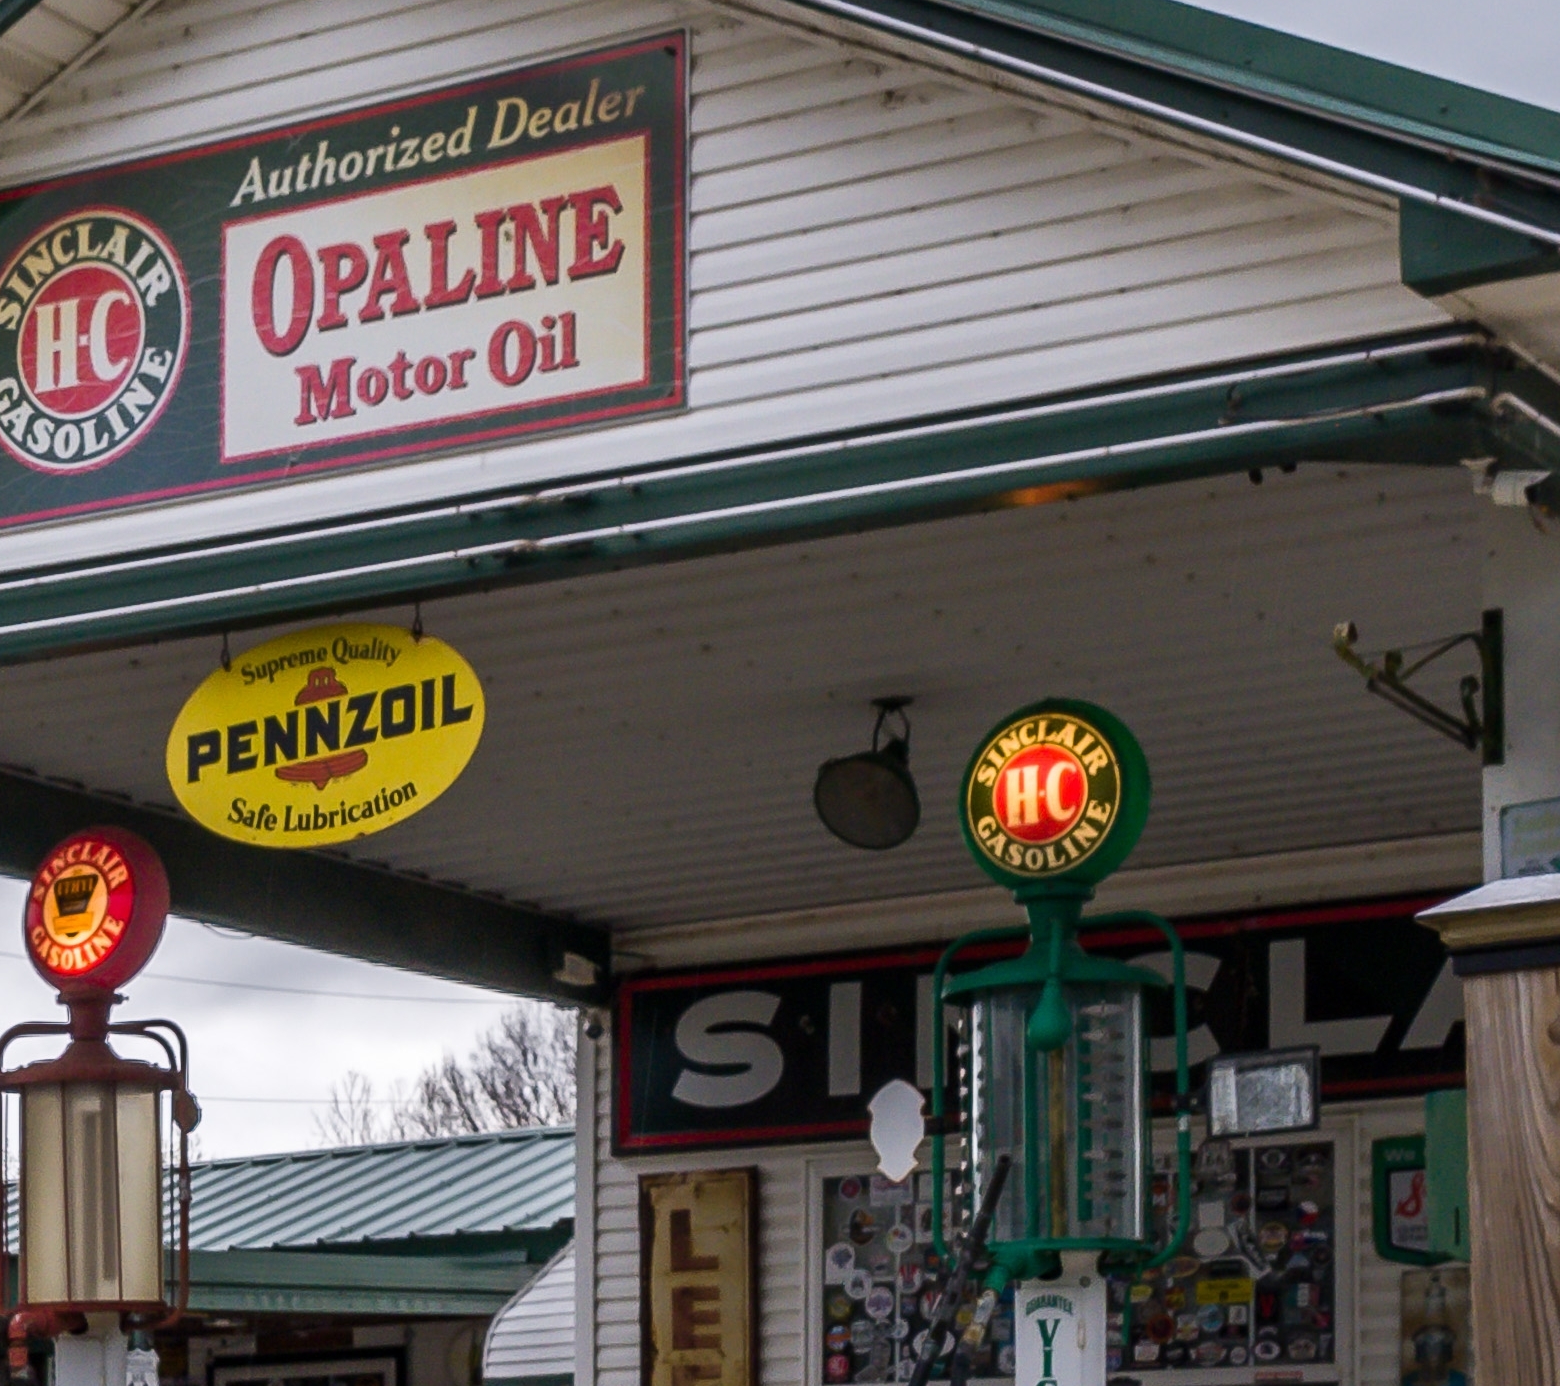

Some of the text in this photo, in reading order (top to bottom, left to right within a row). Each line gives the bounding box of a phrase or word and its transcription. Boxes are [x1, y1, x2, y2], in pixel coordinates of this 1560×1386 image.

[231, 79, 646, 208] Authorized Dealer
[251, 185, 626, 359] OPALINE
[293, 310, 581, 427] Motor Oil
[241, 636, 402, 685] Supreme Quality
[186, 673, 474, 785] PENNZOIL
[975, 718, 1109, 787] SINCLAIR
[226, 780, 419, 833] Safe Lubrication
[976, 798, 1112, 871] GASOLINE
[32, 840, 130, 901] SINCLAIR
[31, 914, 126, 971] GASOLINE
